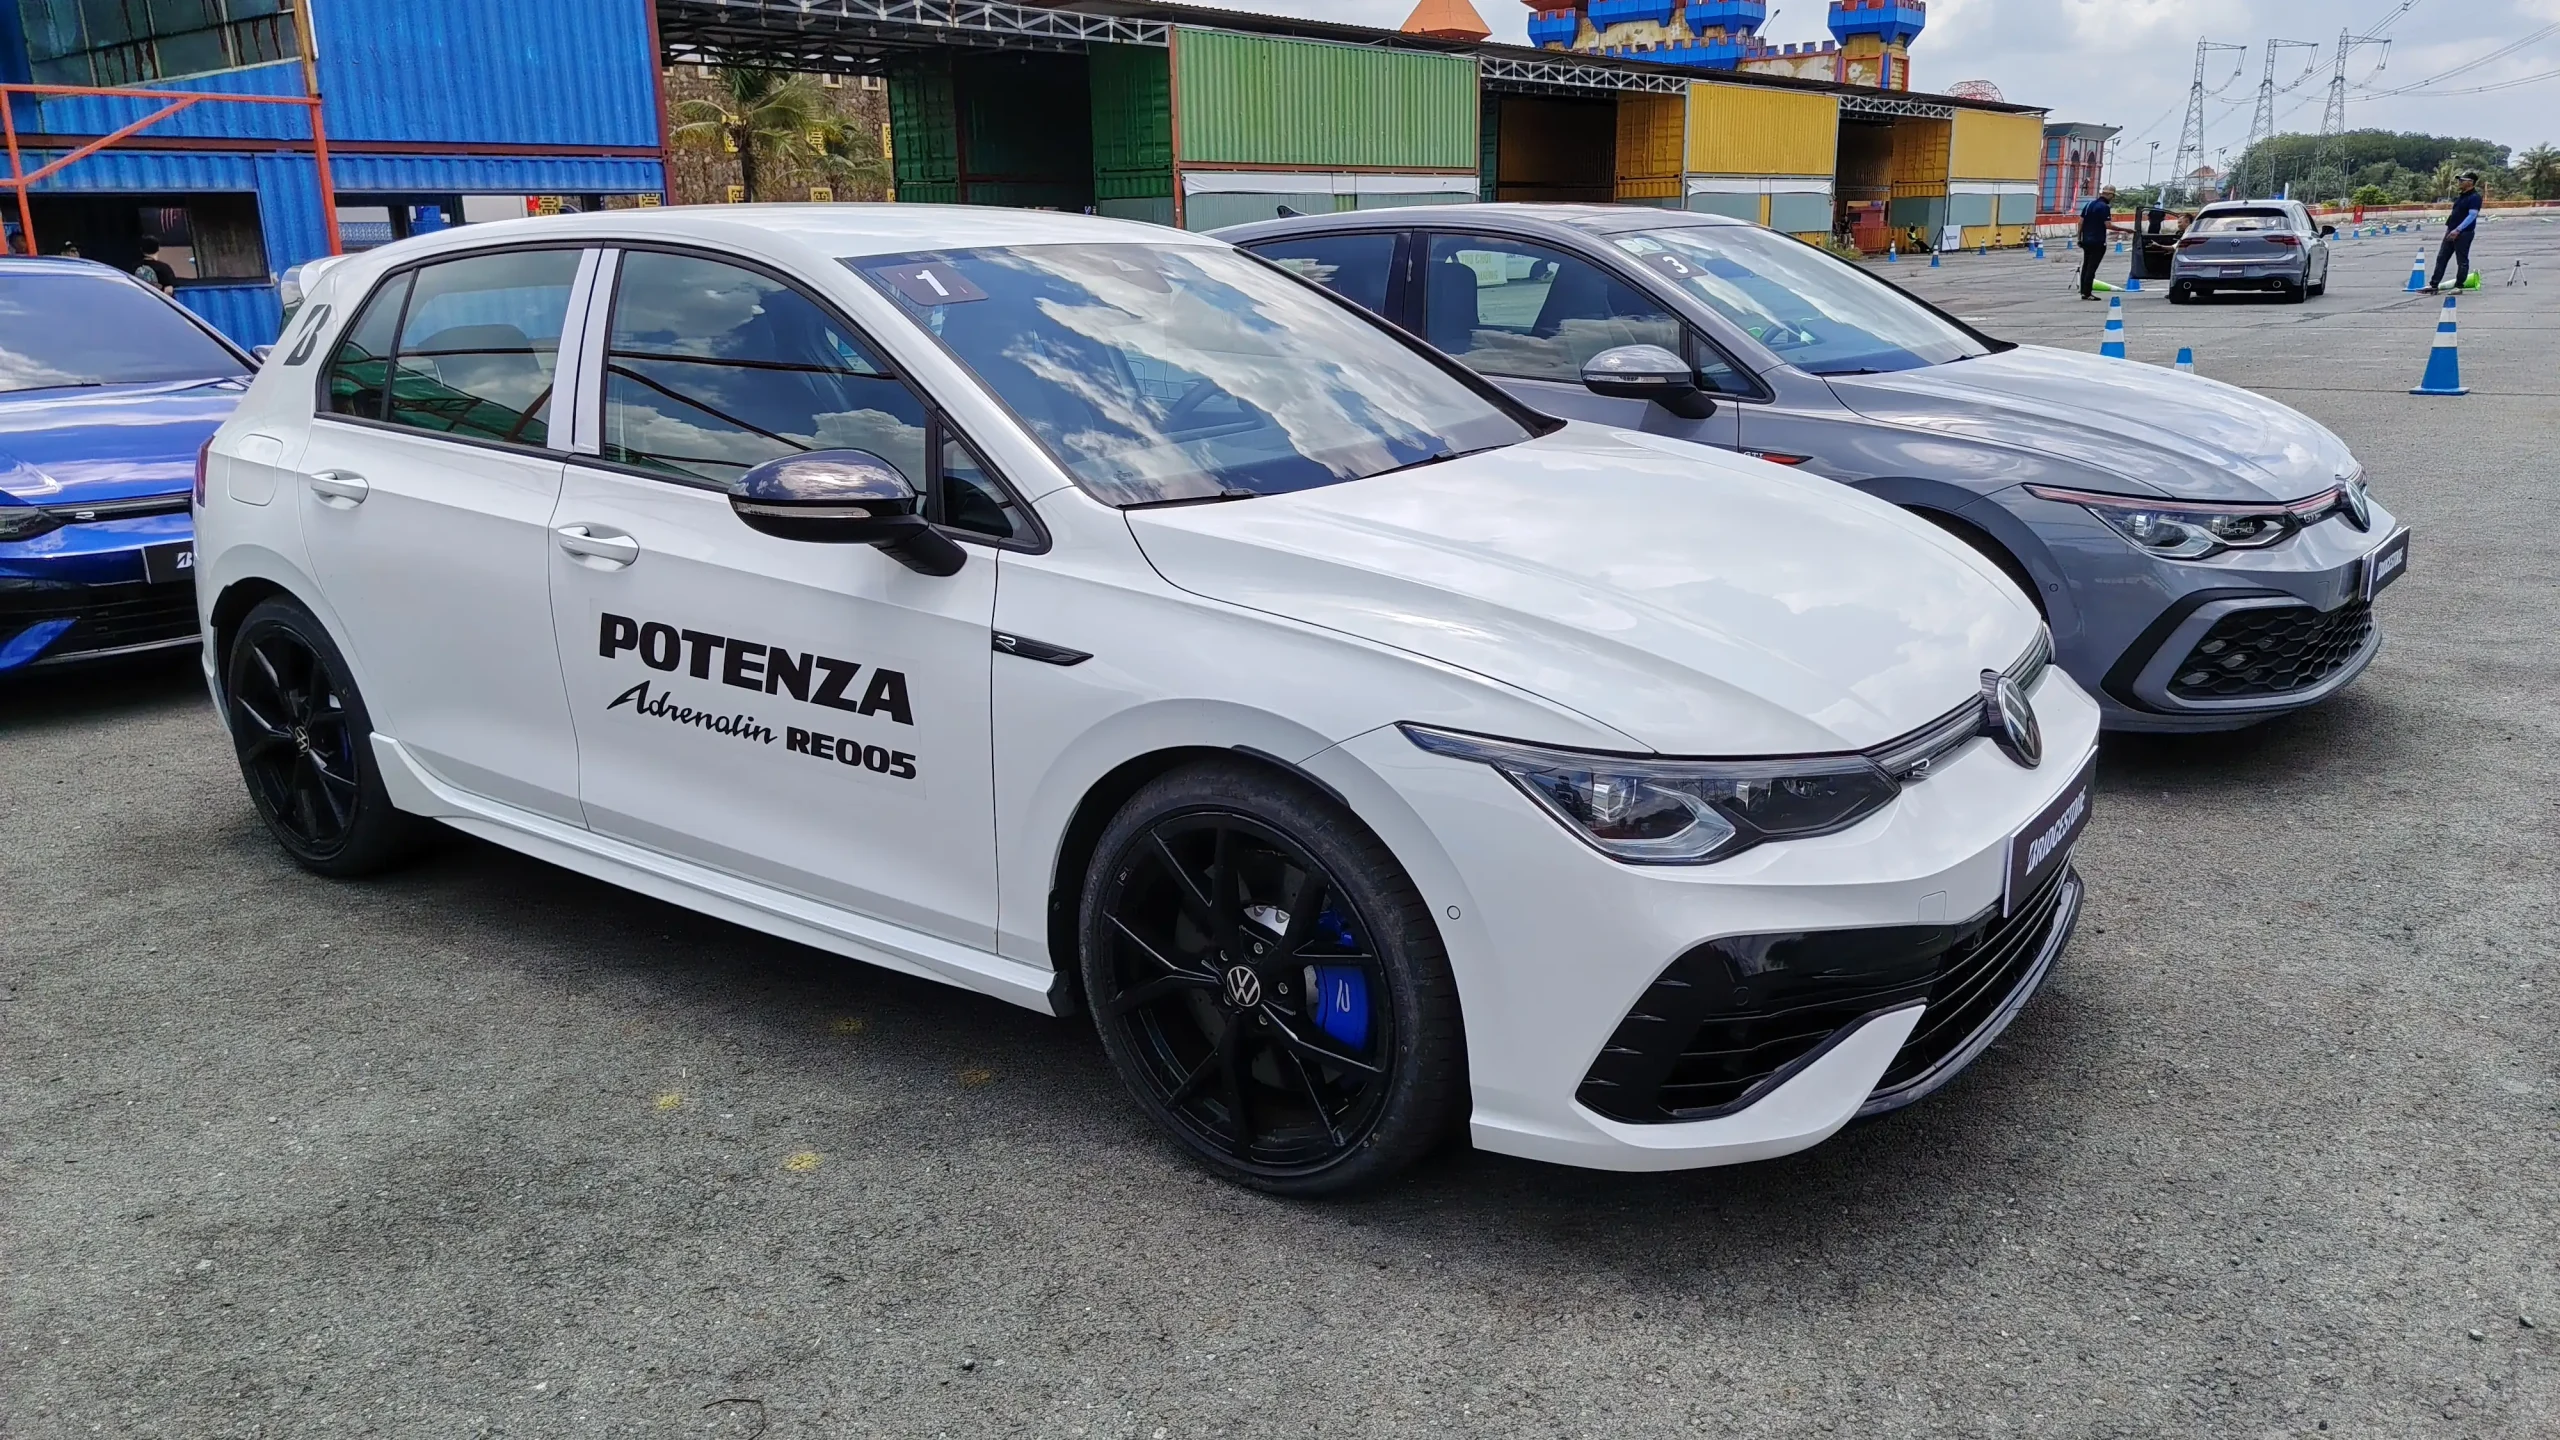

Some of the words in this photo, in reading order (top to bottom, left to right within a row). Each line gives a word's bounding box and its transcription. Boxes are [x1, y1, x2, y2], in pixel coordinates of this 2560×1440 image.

[915, 269, 950, 297] 1
[1662, 256, 1689, 274] 3
[599, 612, 914, 726] POTENZA
[606, 680, 778, 744] Adrenalin
[786, 726, 917, 780] RE005
[2026, 785, 2087, 876] BRIDGESTONE
